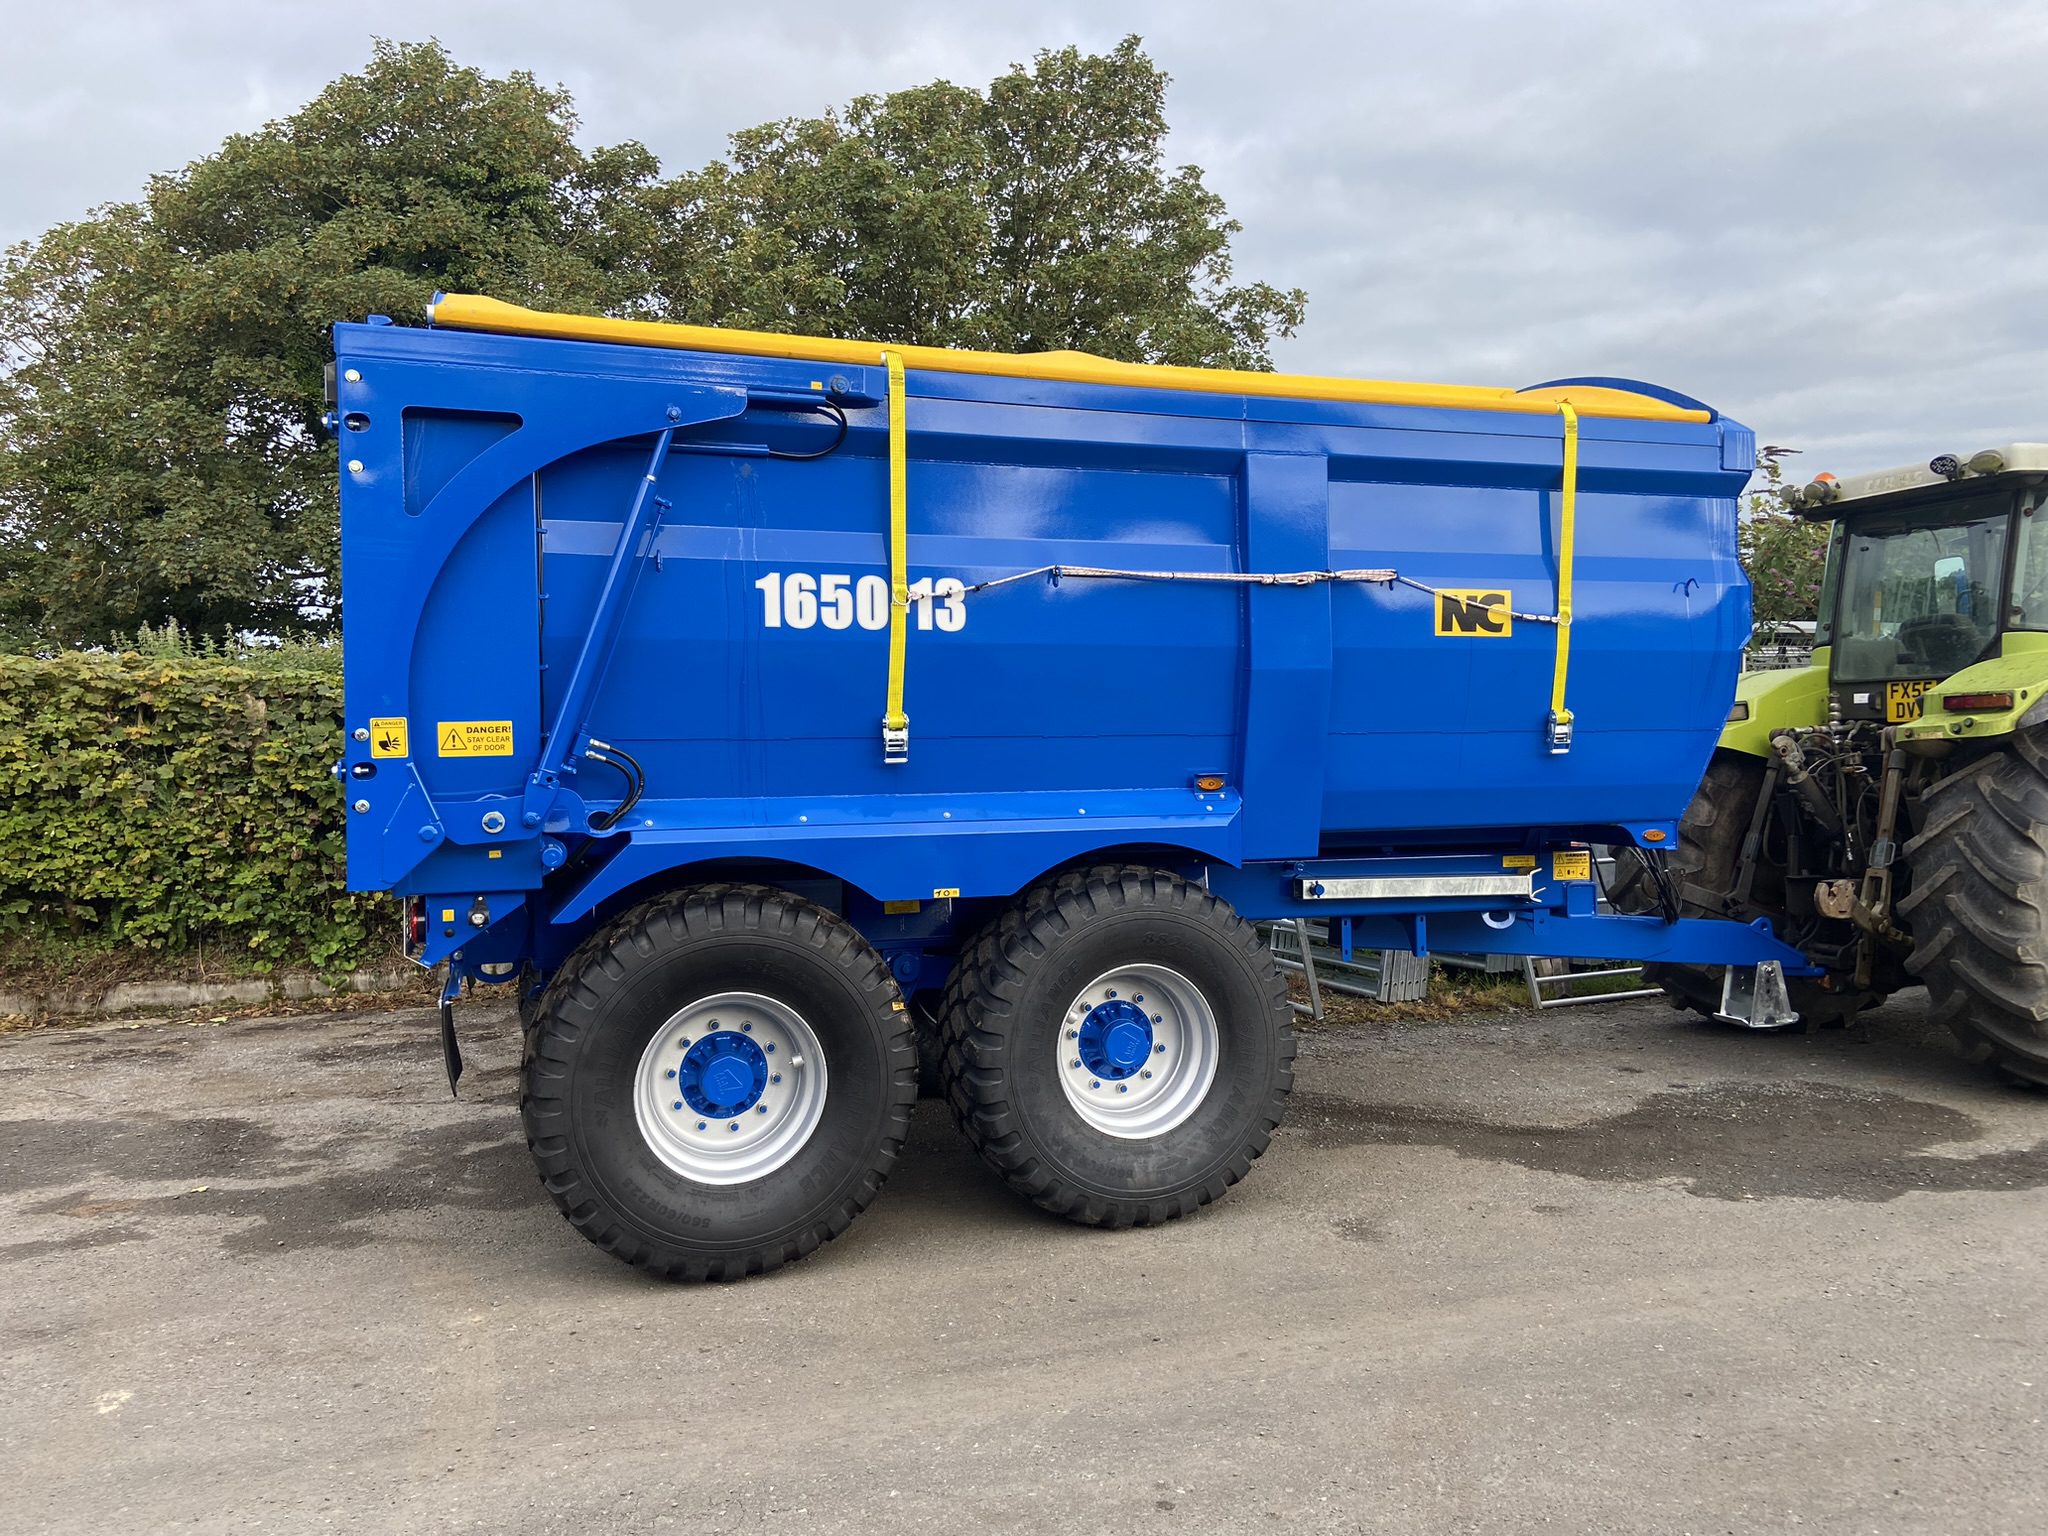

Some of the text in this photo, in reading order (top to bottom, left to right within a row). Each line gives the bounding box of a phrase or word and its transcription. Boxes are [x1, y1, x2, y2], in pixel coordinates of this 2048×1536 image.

[755, 572, 967, 632] 165013
[1441, 593, 1505, 633] NC
[1896, 702, 1922, 718] DV
[466, 725, 512, 734] DANGER!
[486, 735, 511, 743] CLEAR
